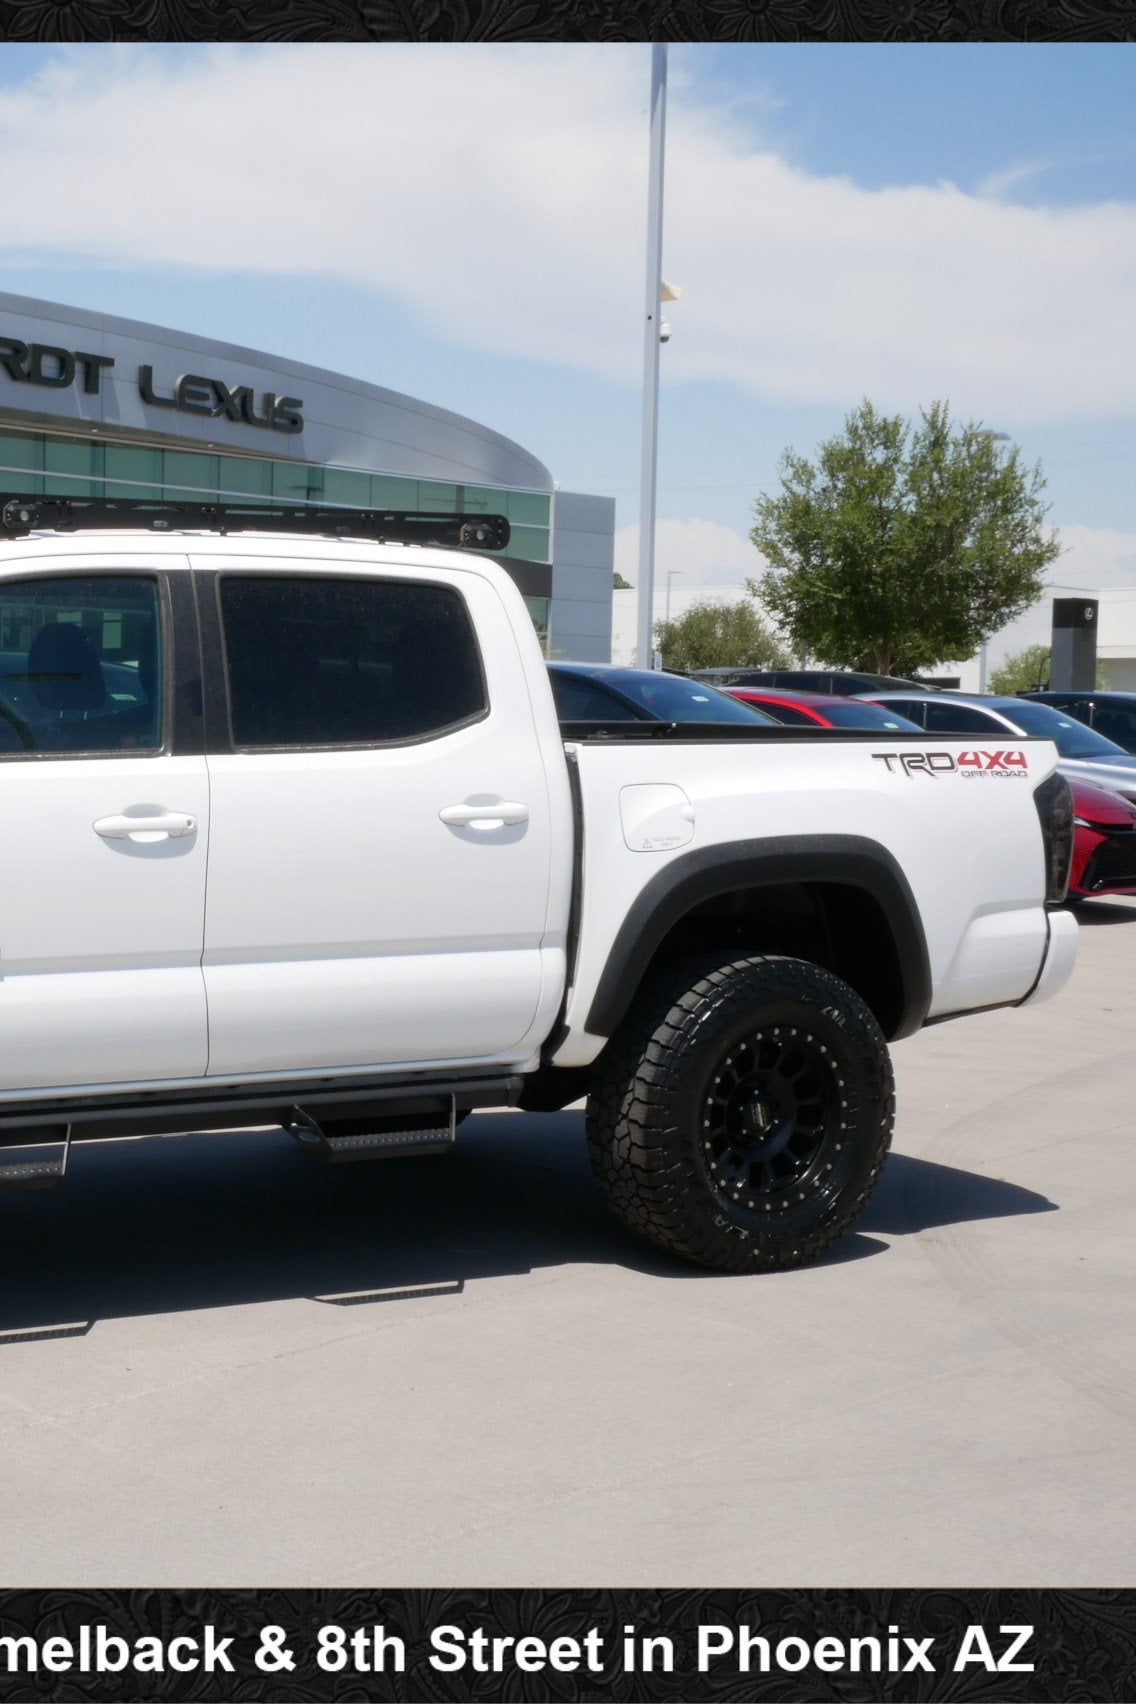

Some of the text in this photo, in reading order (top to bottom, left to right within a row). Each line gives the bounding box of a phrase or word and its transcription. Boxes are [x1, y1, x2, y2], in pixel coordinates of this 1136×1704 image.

[138, 364, 304, 434] LEXUS
[871, 752, 958, 779] TRD
[961, 770, 1028, 778] OFF ROAD
